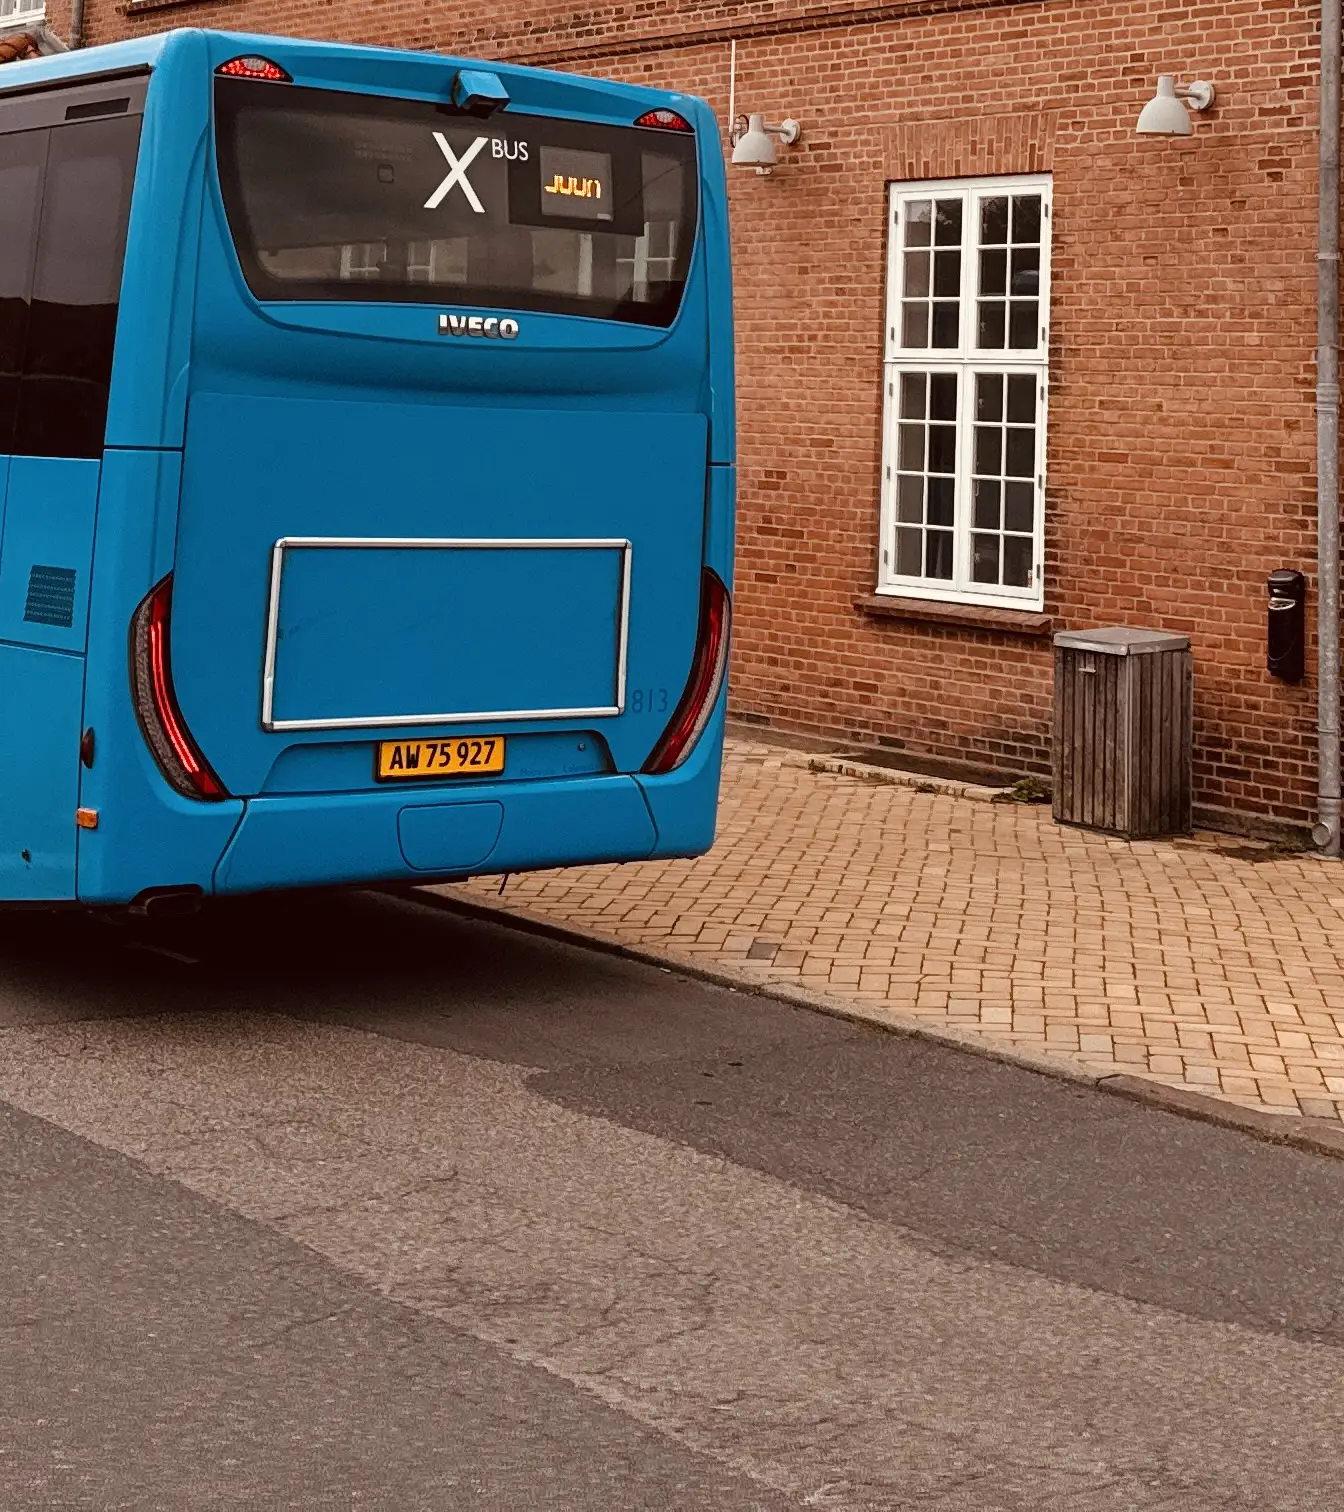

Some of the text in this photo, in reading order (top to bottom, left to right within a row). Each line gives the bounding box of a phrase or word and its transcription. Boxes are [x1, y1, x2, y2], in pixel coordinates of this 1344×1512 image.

[423, 131, 529, 213] X BUS
[439, 314, 519, 339] IVECO
[632, 689, 668, 713] 813
[389, 740, 496, 770] AW 75 927
